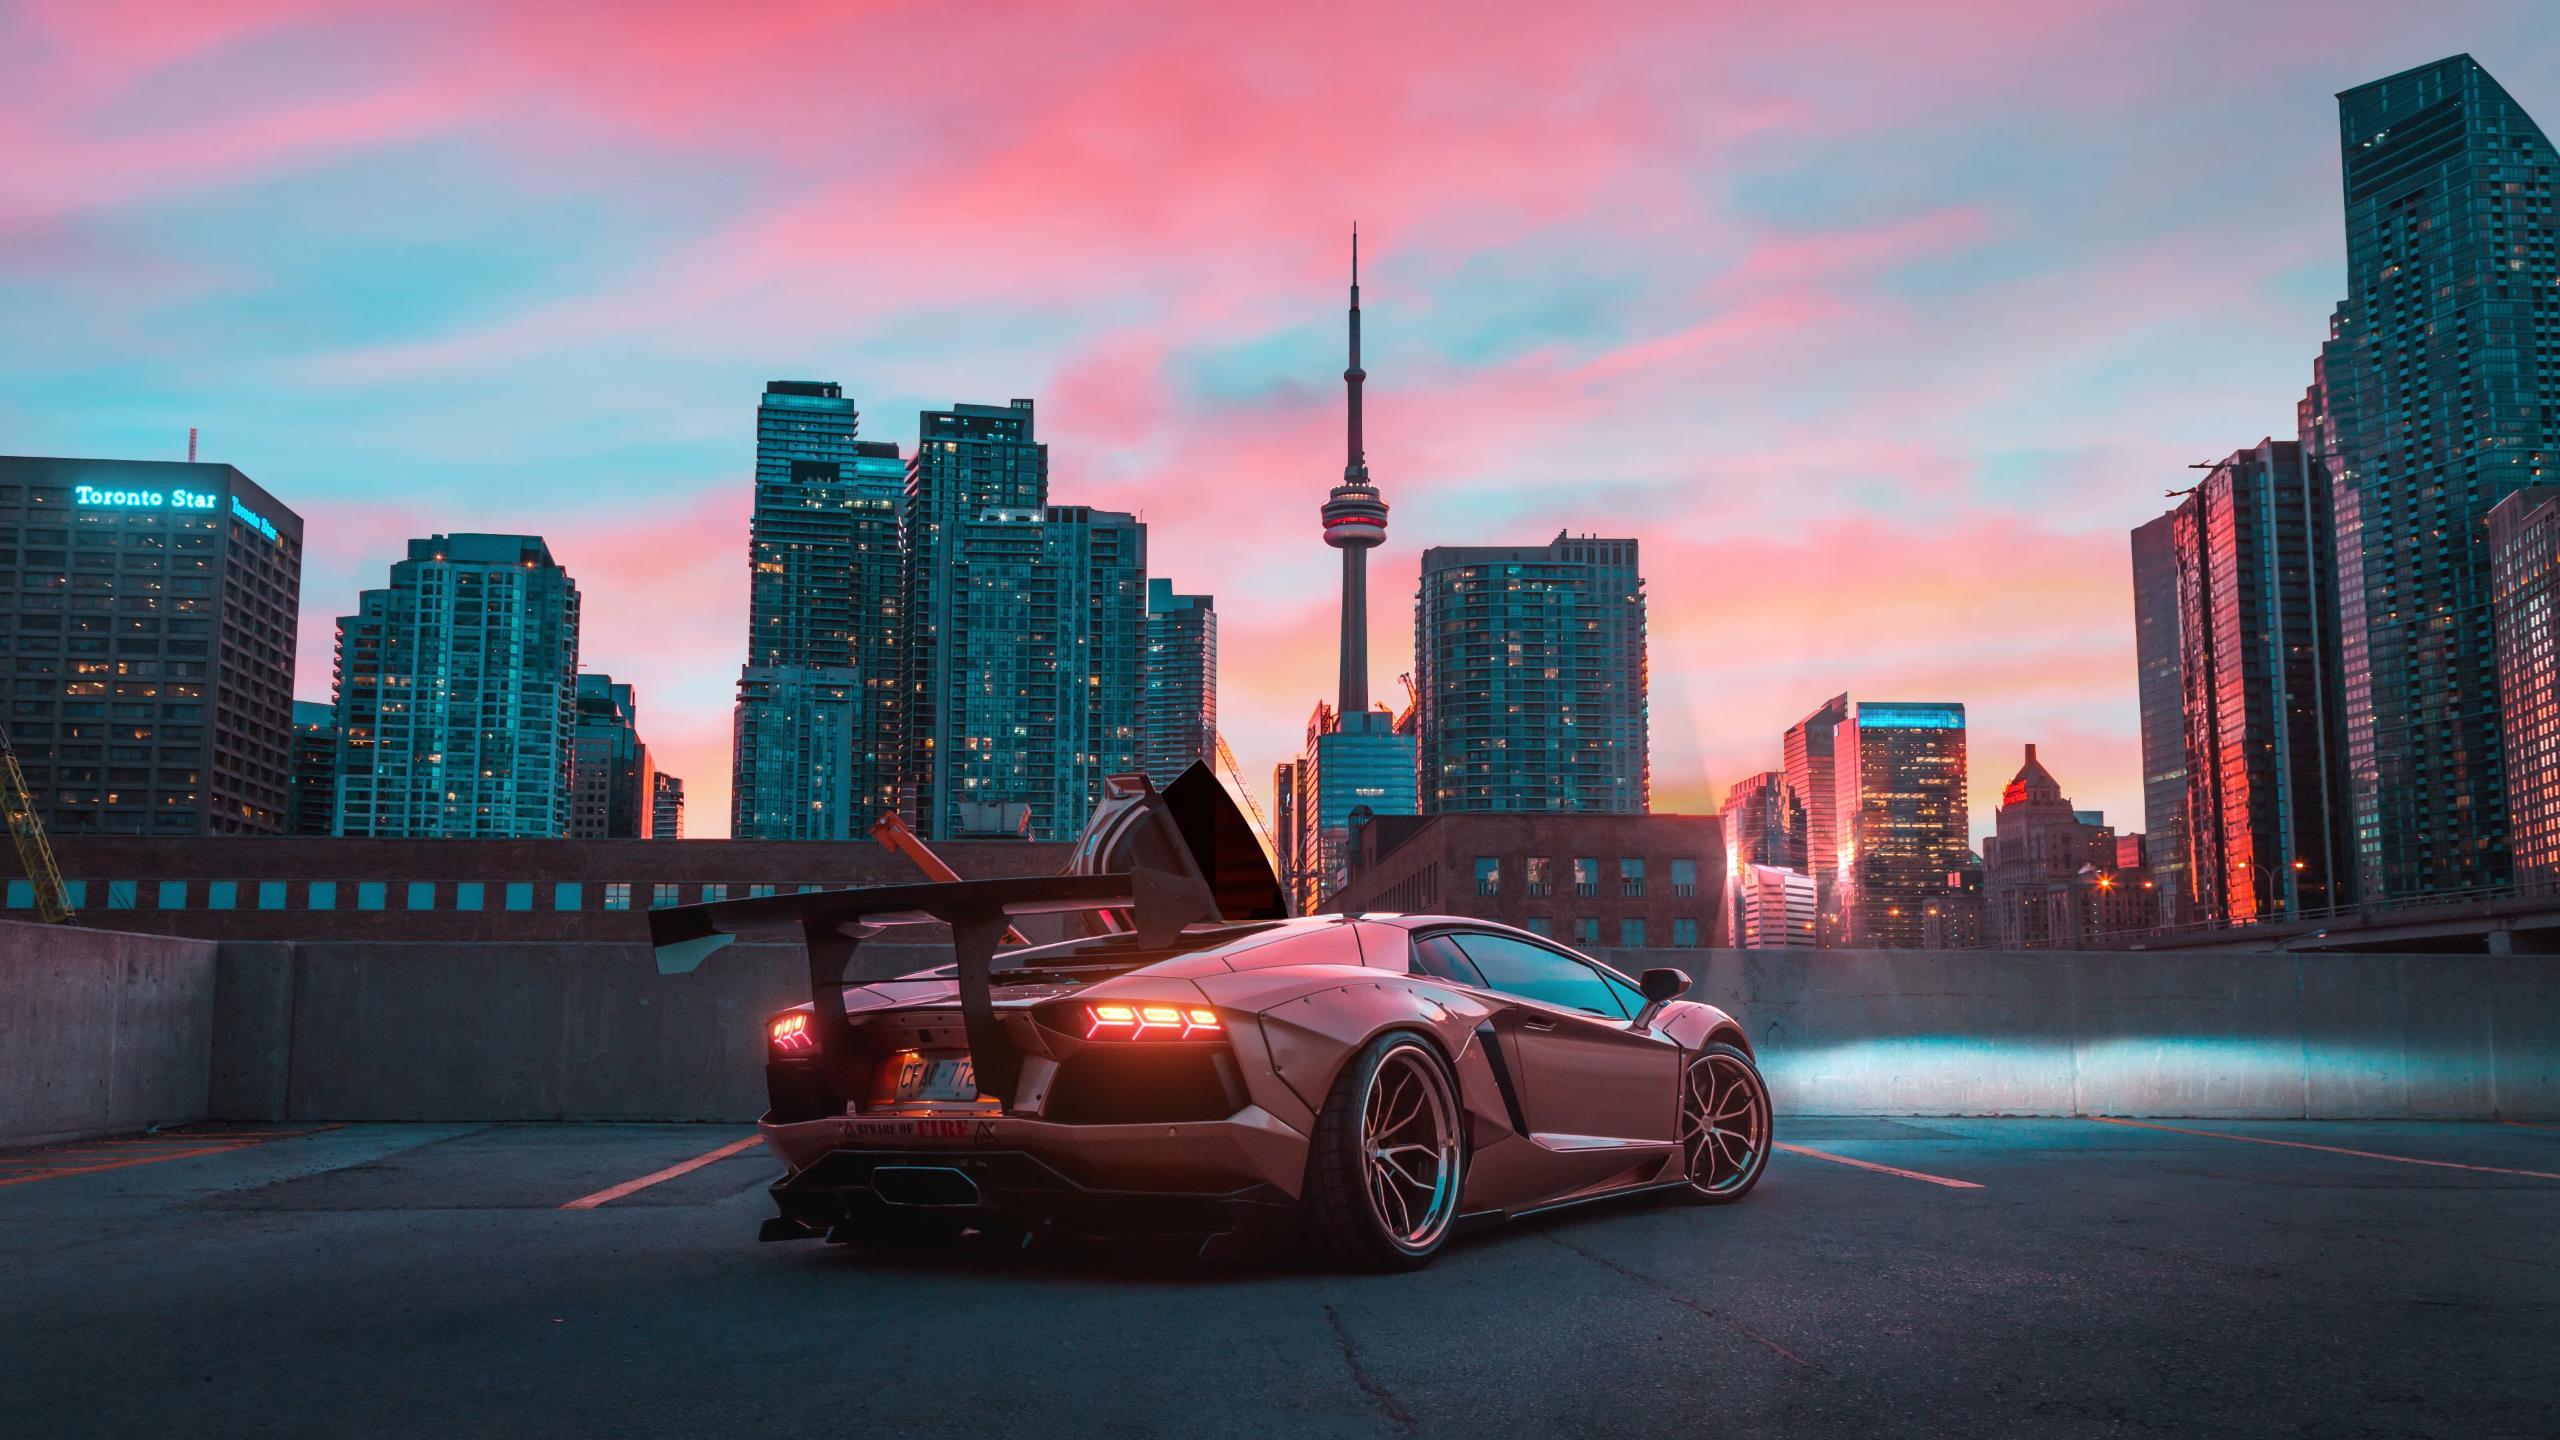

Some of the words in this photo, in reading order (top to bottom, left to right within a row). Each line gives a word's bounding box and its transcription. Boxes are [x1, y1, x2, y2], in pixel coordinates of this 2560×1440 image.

[75, 485, 163, 506] Toronto
[171, 489, 216, 508] Star
[231, 495, 260, 528] Toronto
[857, 1123, 896, 1136] BEWARE
[899, 1122, 914, 1135] OF
[917, 1119, 969, 1137] FIRE
